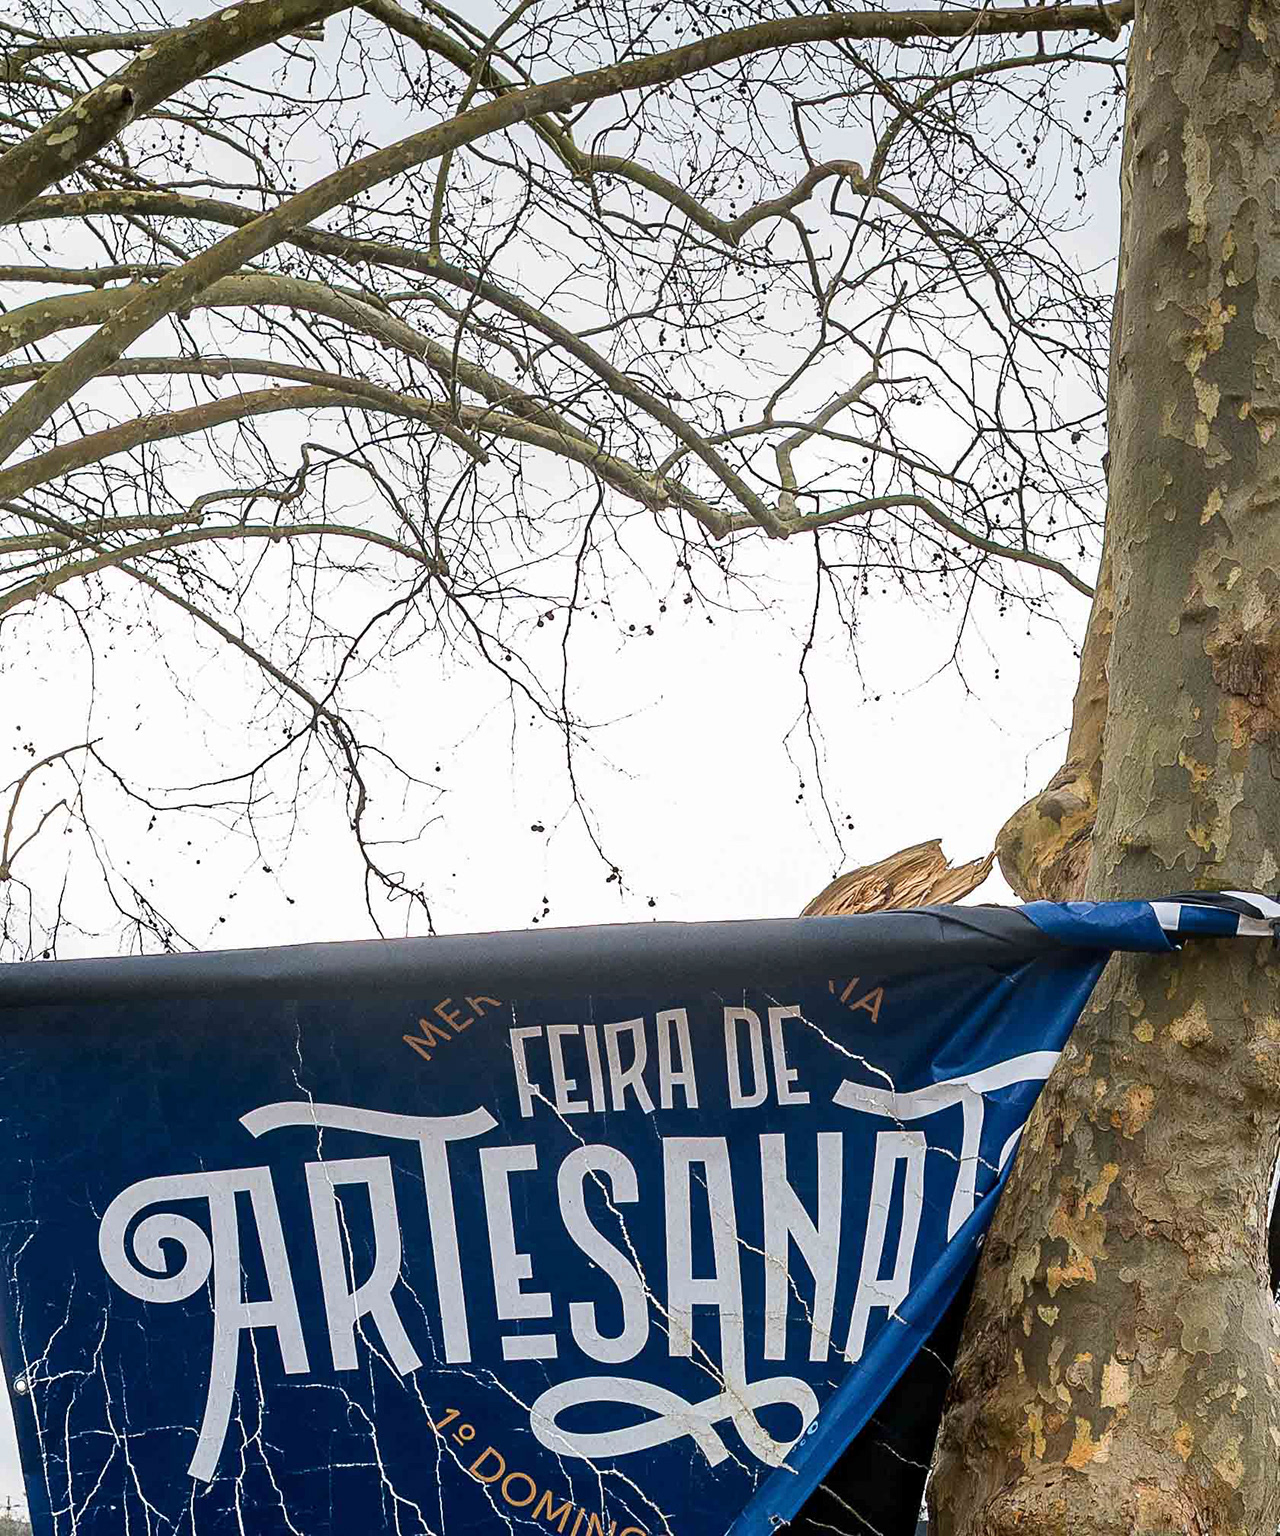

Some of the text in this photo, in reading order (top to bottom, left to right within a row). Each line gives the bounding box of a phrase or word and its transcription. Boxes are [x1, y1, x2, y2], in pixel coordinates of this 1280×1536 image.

[827, 976, 884, 1024] IA
[508, 1004, 812, 1118] FEIRA DE
[98, 1051, 1061, 1482] ARTESANAT
